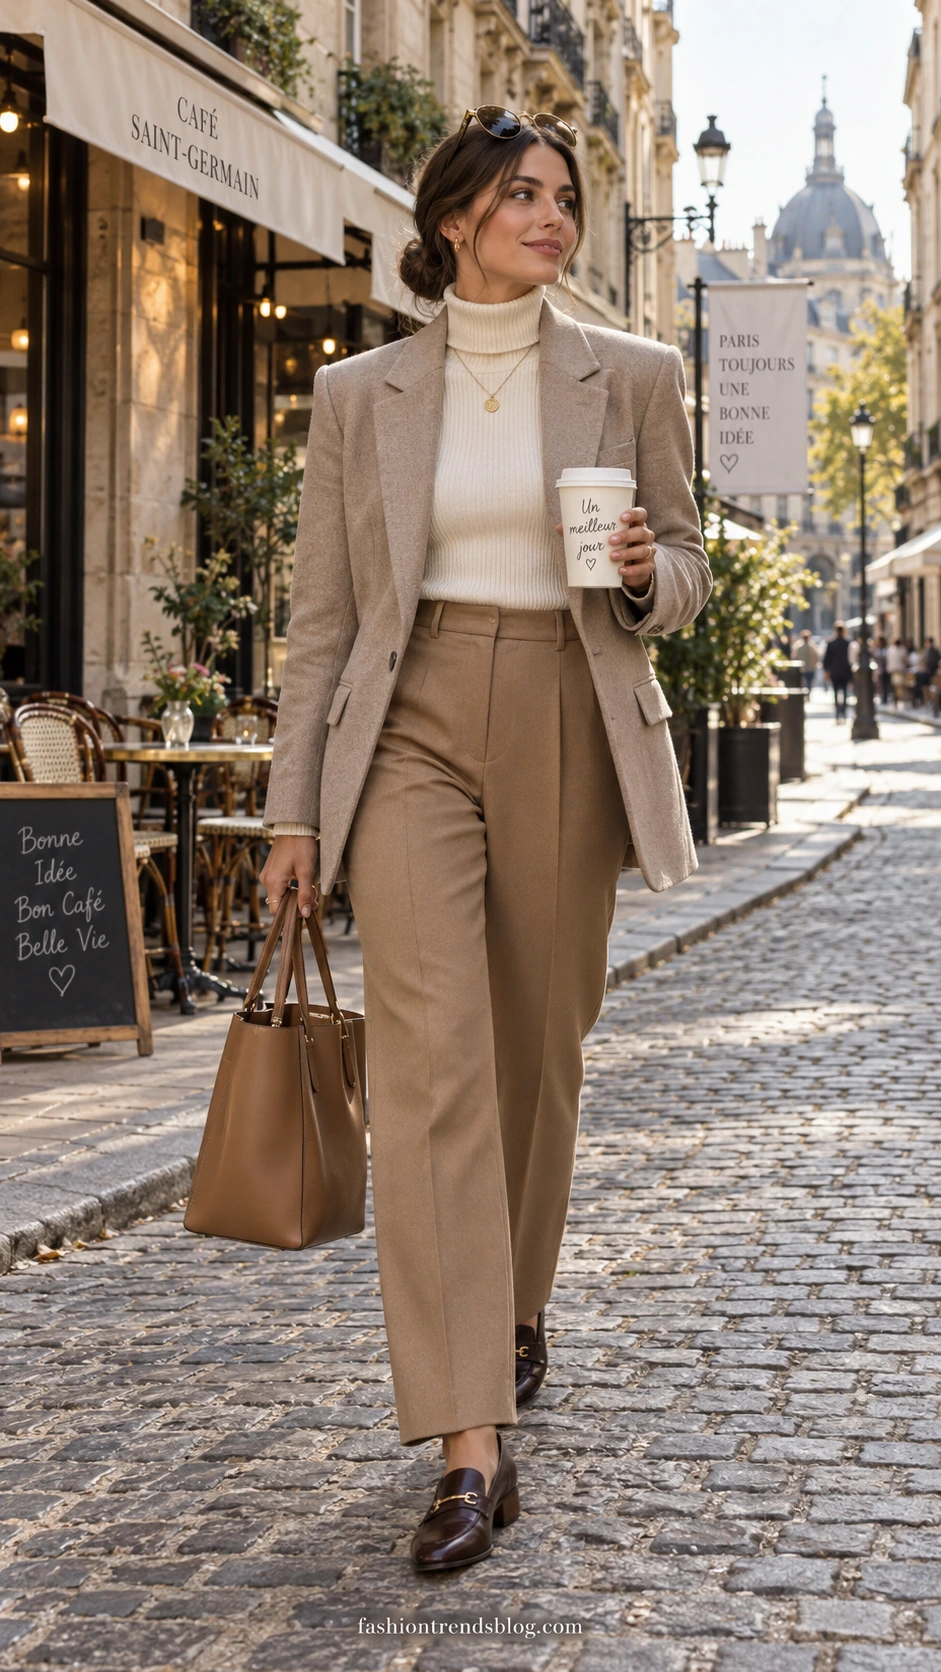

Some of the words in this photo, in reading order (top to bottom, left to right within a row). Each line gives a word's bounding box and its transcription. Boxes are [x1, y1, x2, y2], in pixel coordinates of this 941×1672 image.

[177, 96, 218, 140] CAFÉ
[131, 114, 259, 200] SAINT-GERMAIN
[719, 334, 759, 348] PARIS
[719, 357, 795, 375] TOUJOURS
[719, 382, 749, 396] UNE
[719, 406, 770, 420] BONNE
[719, 427, 754, 445] IDÉE
[581, 498, 600, 514] Un
[569, 517, 617, 535] meilleur
[576, 541, 605, 561] jour
[17, 826, 84, 855] Bonne
[34, 858, 77, 886] Idée
[14, 895, 54, 923] Bon
[62, 887, 105, 923] Café
[15, 928, 68, 961] Belle
[76, 925, 110, 952] Vie
